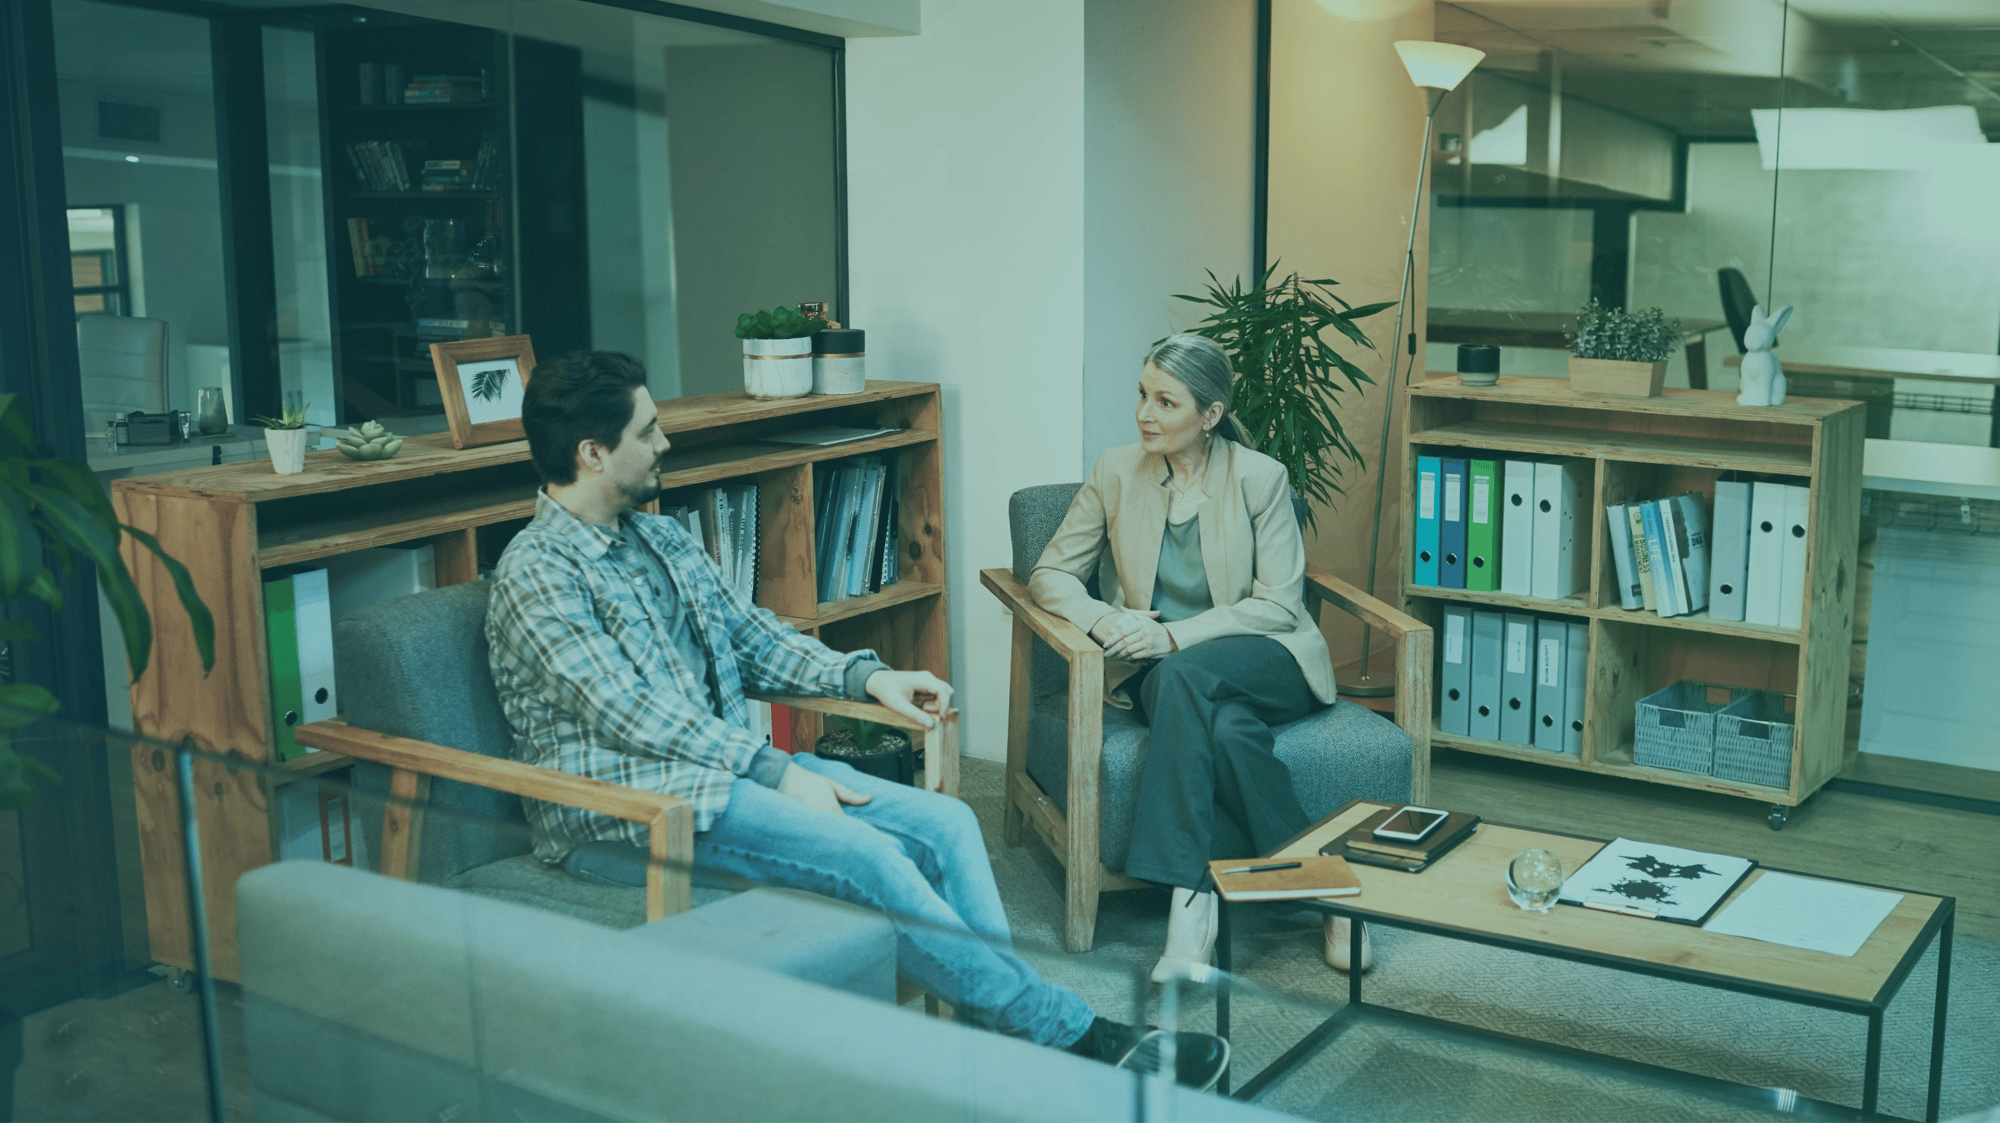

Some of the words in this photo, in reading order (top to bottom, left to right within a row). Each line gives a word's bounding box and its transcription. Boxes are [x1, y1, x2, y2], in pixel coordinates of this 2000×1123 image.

[1648, 539, 1661, 561] LIFE
[1691, 535, 1703, 547] DNA
[1640, 540, 1651, 574] BUSINESS
